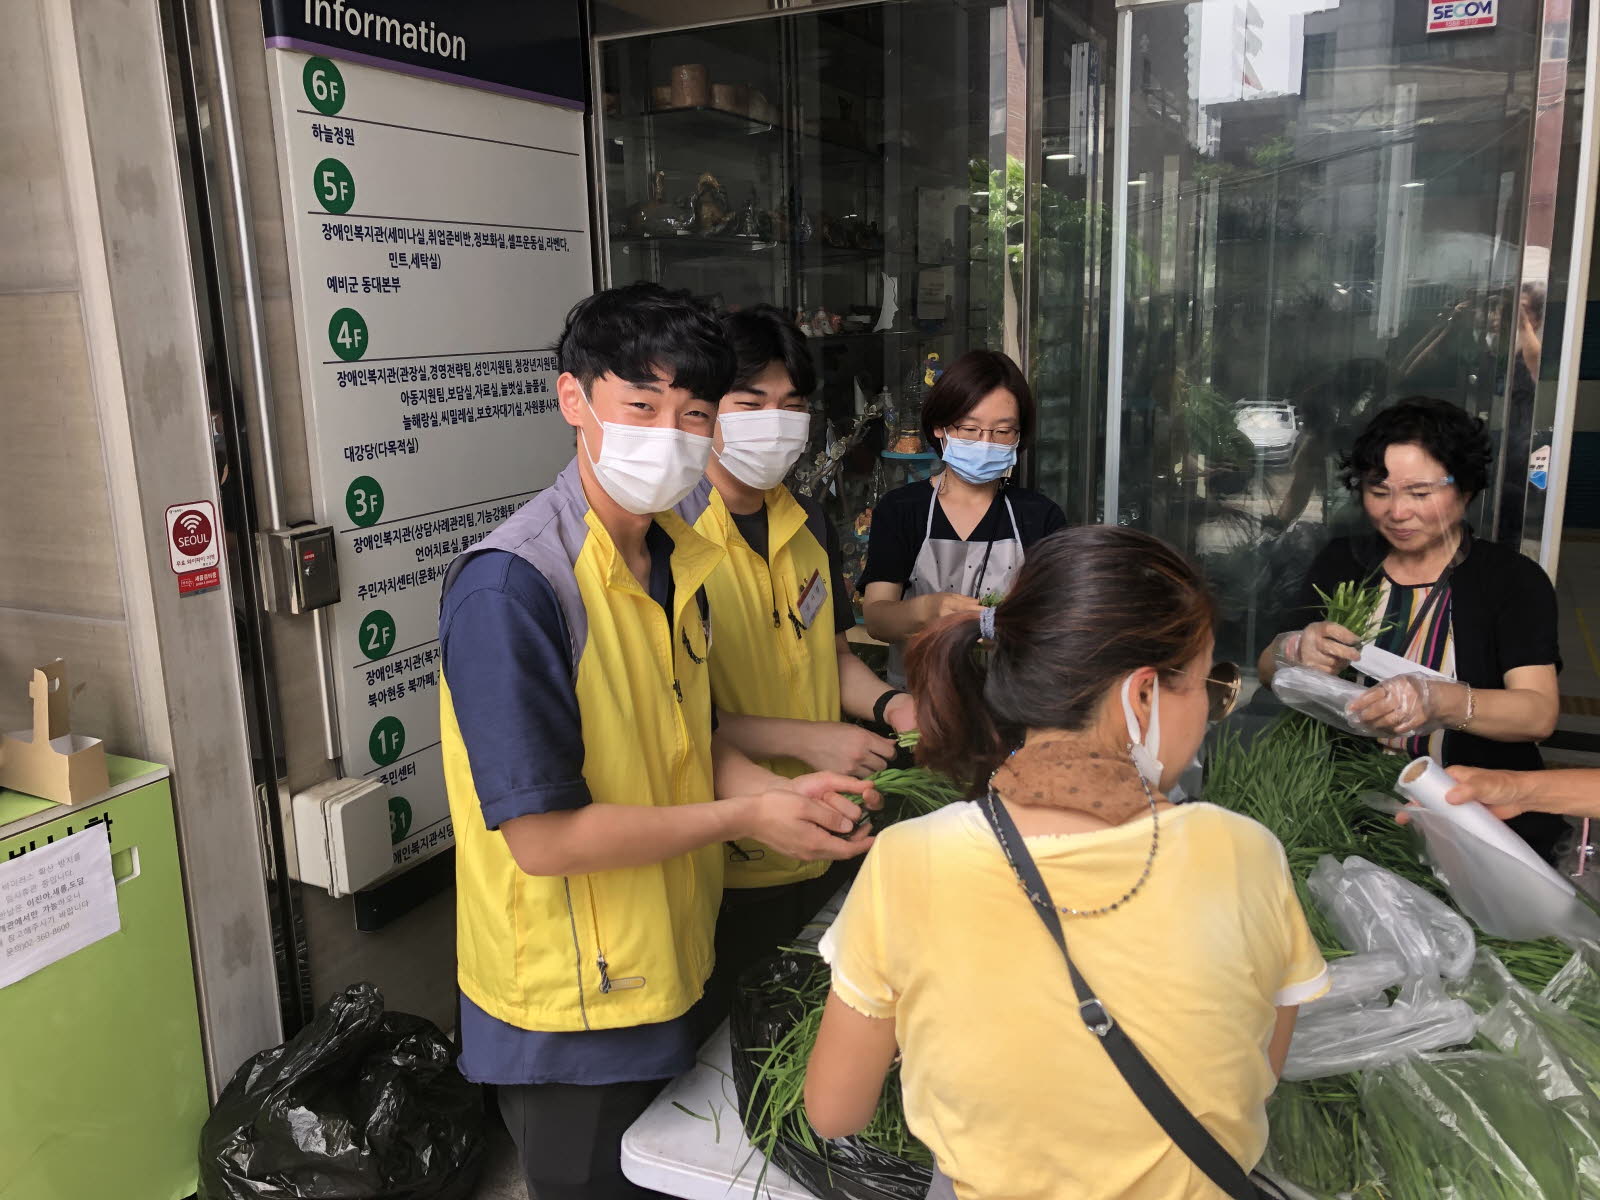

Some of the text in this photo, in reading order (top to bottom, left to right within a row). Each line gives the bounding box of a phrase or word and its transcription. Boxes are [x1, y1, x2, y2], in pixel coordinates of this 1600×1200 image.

[1433, 1, 1492, 20] SECOM
[305, 0, 467, 61] Information
[311, 70, 339, 102] 6F
[311, 124, 355, 146] 하늘정원
[322, 171, 349, 201] 5F
[388, 252, 441, 270] 민트,세탁실)
[327, 276, 401, 294] 예비군 동대본부
[337, 321, 362, 349] 4F
[344, 437, 419, 462] 대강당(다목적실)
[353, 489, 378, 517] 3F
[178, 533, 209, 547] SEOUL
[366, 623, 390, 651] 2F
[368, 682, 406, 708] 북아현동
[377, 730, 399, 755] 1F
[380, 761, 416, 786] 주민센터
